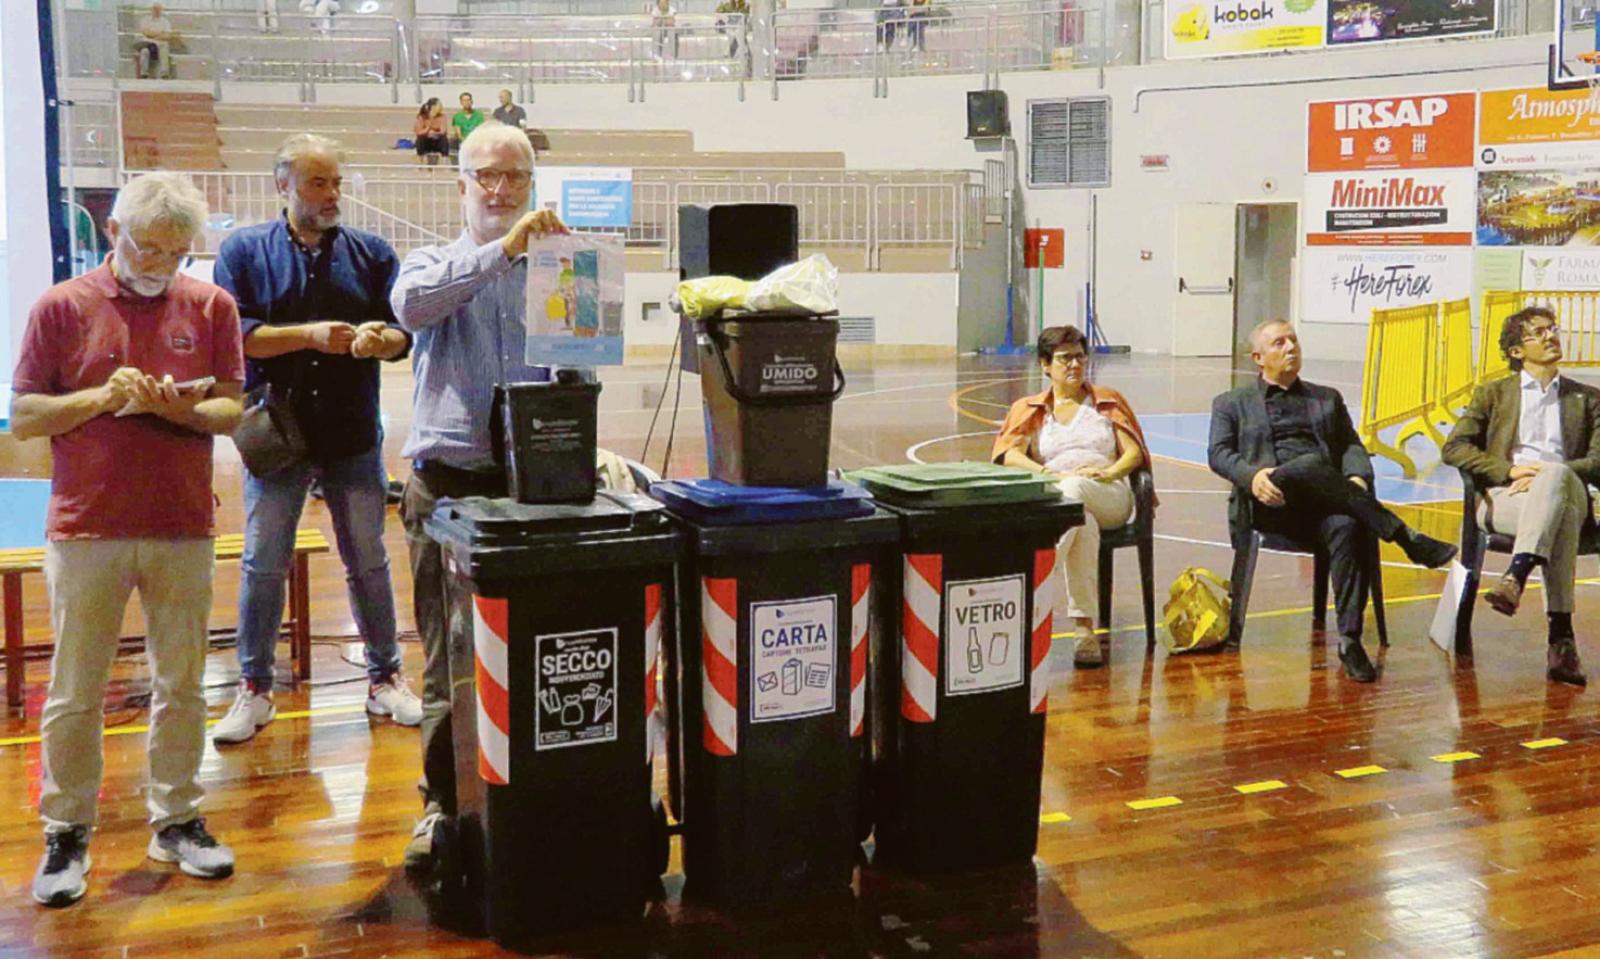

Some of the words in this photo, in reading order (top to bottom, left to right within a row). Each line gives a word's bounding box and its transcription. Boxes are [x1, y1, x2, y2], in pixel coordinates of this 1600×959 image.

[1214, 1, 1273, 23] kobak
[1334, 97, 1448, 131] IRSAP
[1331, 178, 1446, 207] MiniMax
[762, 368, 818, 380] UMIDO
[955, 601, 1017, 626] VETRO
[761, 623, 828, 648] CARTA
[542, 648, 612, 676] SECCO
